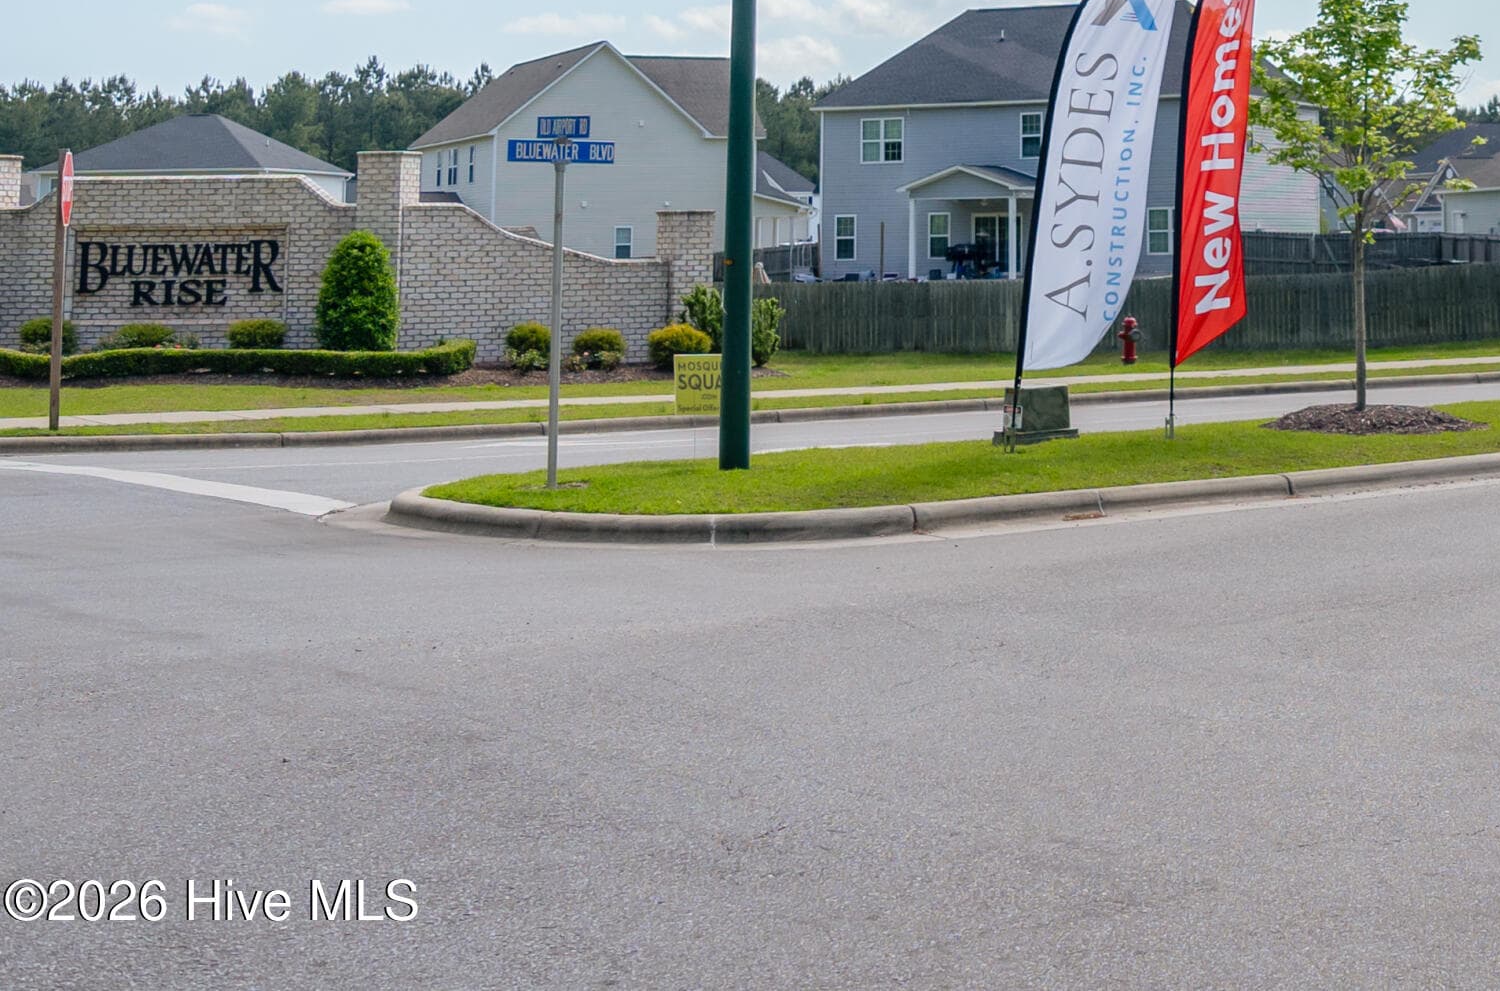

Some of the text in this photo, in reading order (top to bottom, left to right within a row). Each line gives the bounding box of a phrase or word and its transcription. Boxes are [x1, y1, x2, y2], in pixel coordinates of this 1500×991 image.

[1126, 56, 1147, 106] INC.
[515, 142, 614, 161] BLUEWATER BLVD
[1044, 52, 1119, 323] A.SYDES
[75, 239, 284, 294] BLUEWATER
[1195, 190, 1235, 316] New
[130, 279, 227, 306] RISE
